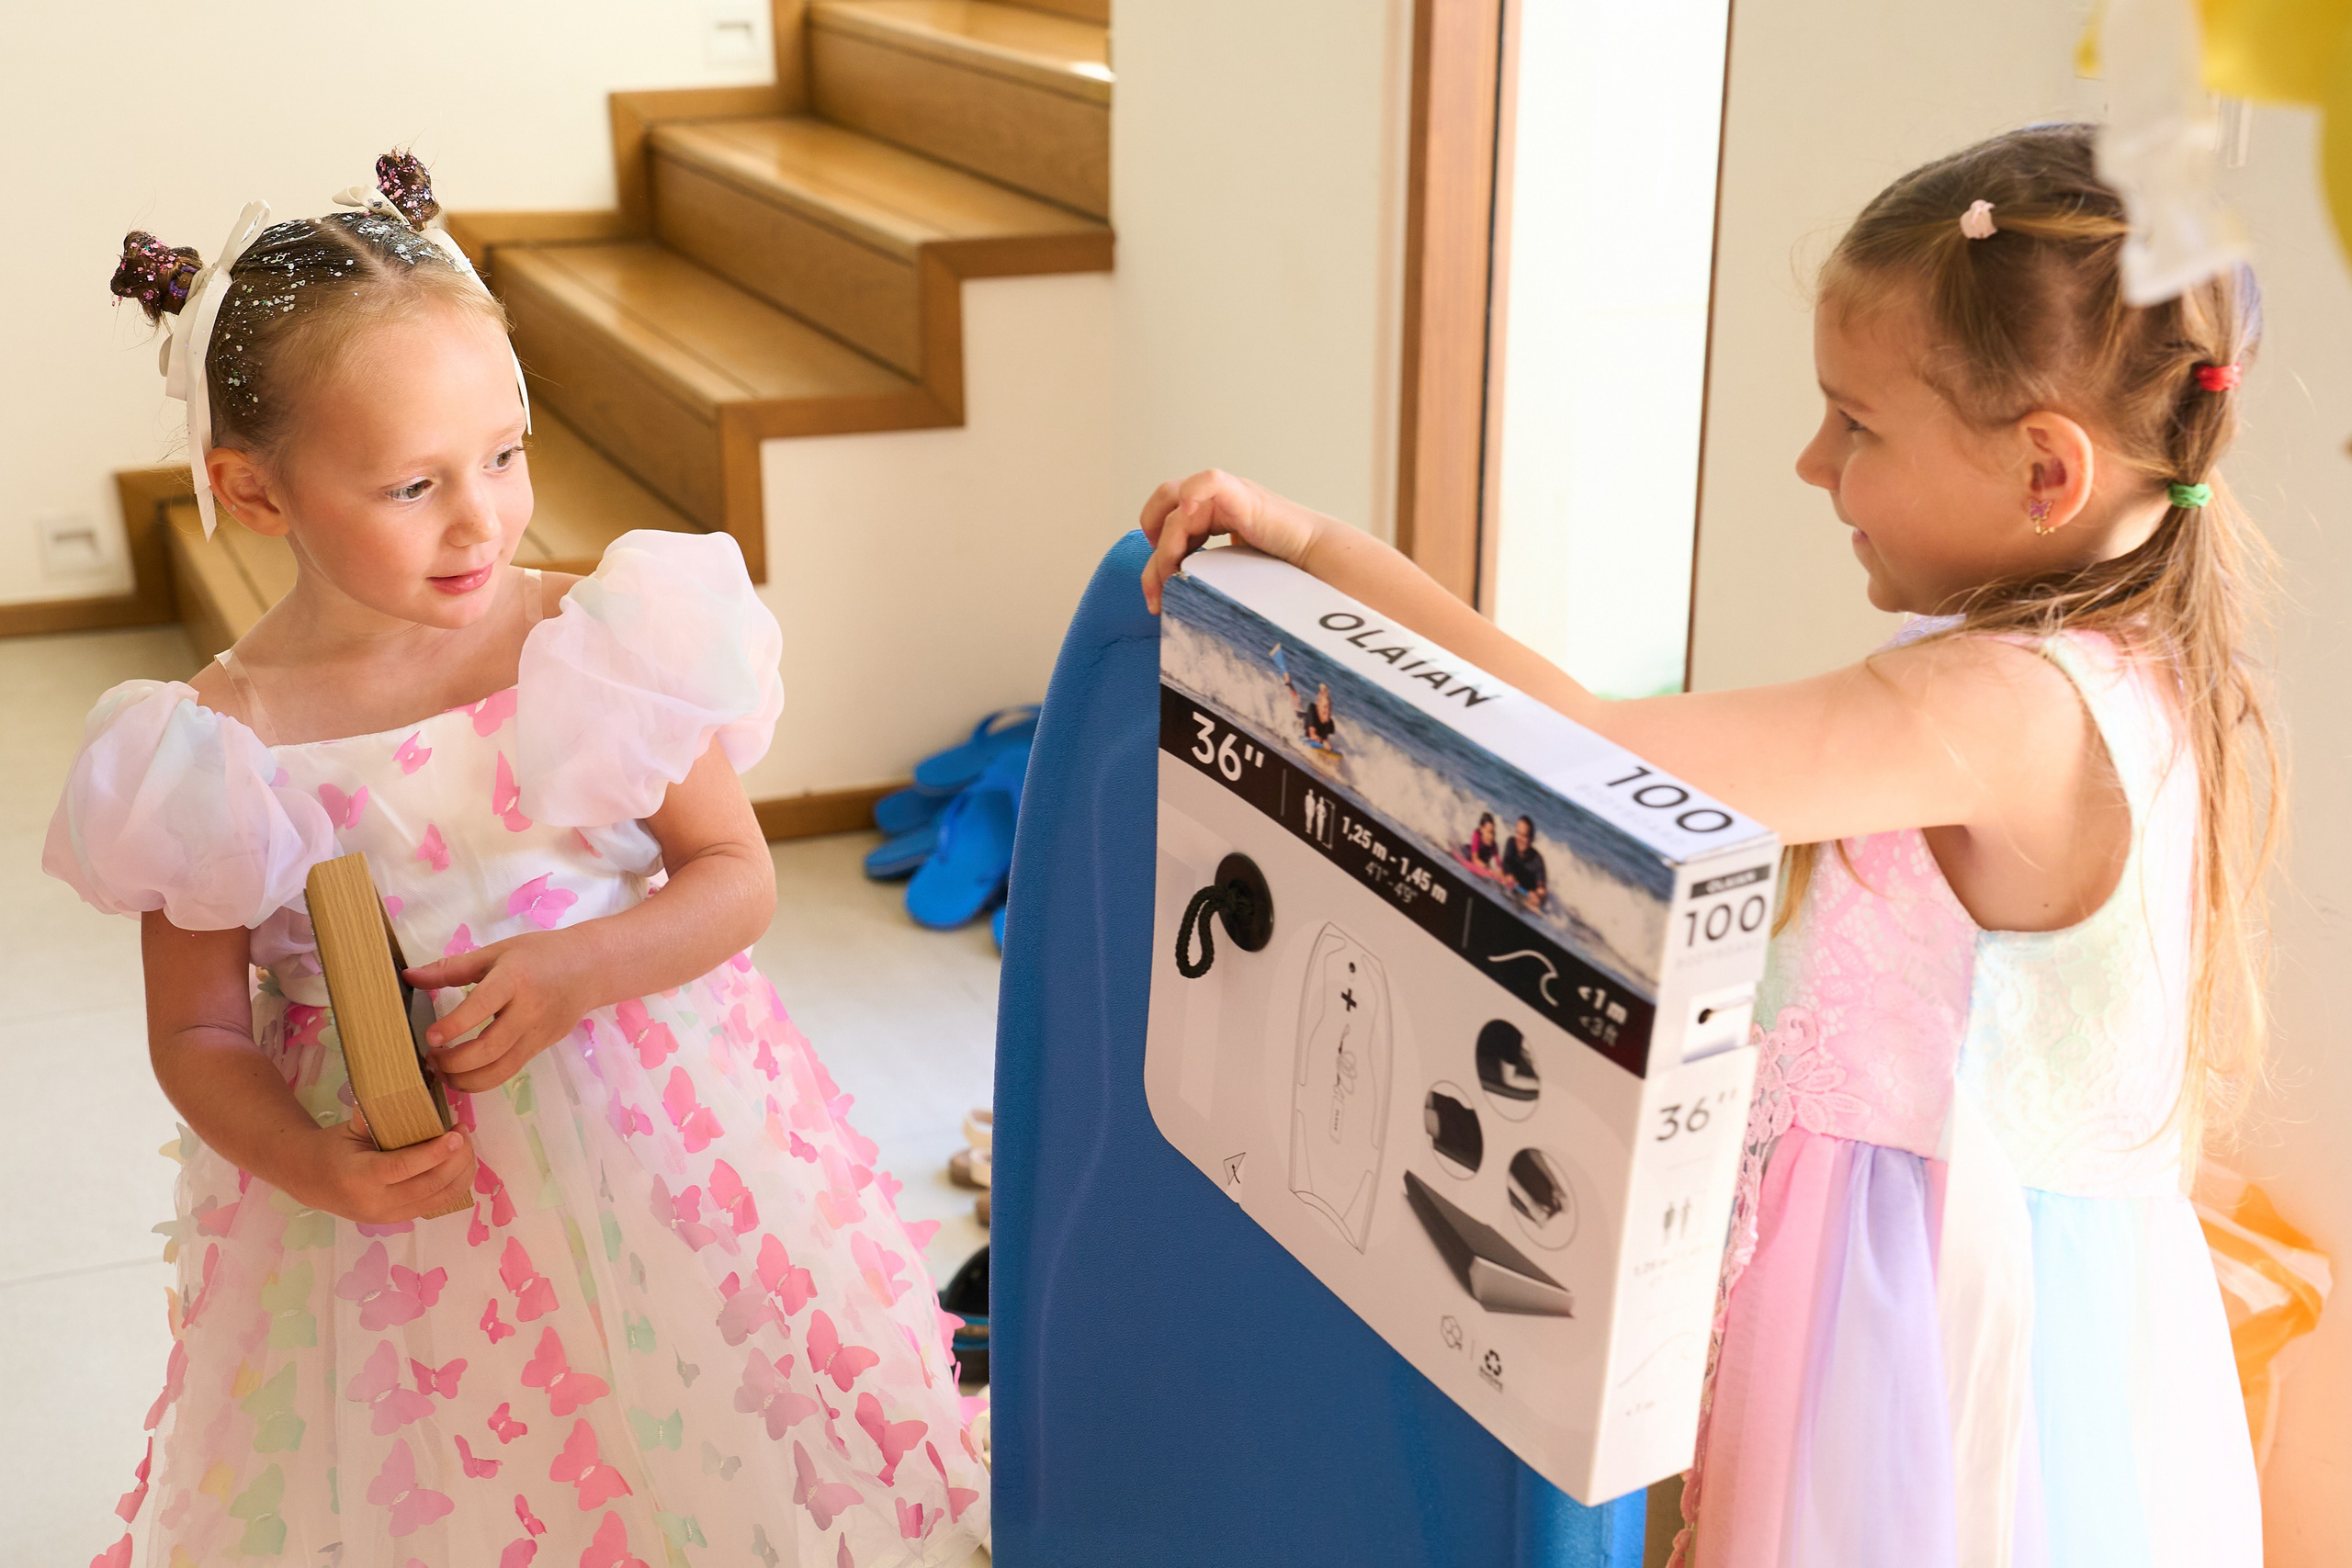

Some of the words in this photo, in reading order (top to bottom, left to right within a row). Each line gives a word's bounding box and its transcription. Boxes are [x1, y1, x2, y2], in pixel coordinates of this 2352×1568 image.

[1318, 613, 1501, 707] OLAIAN
[1191, 711, 1264, 782] 36"
[1606, 766, 1733, 833] 100
[1342, 816, 1372, 849] 1,25
[1372, 840, 1388, 862] m
[1400, 856, 1432, 892] 1,45
[1430, 883, 1448, 905] m
[1686, 895, 1766, 948] 100
